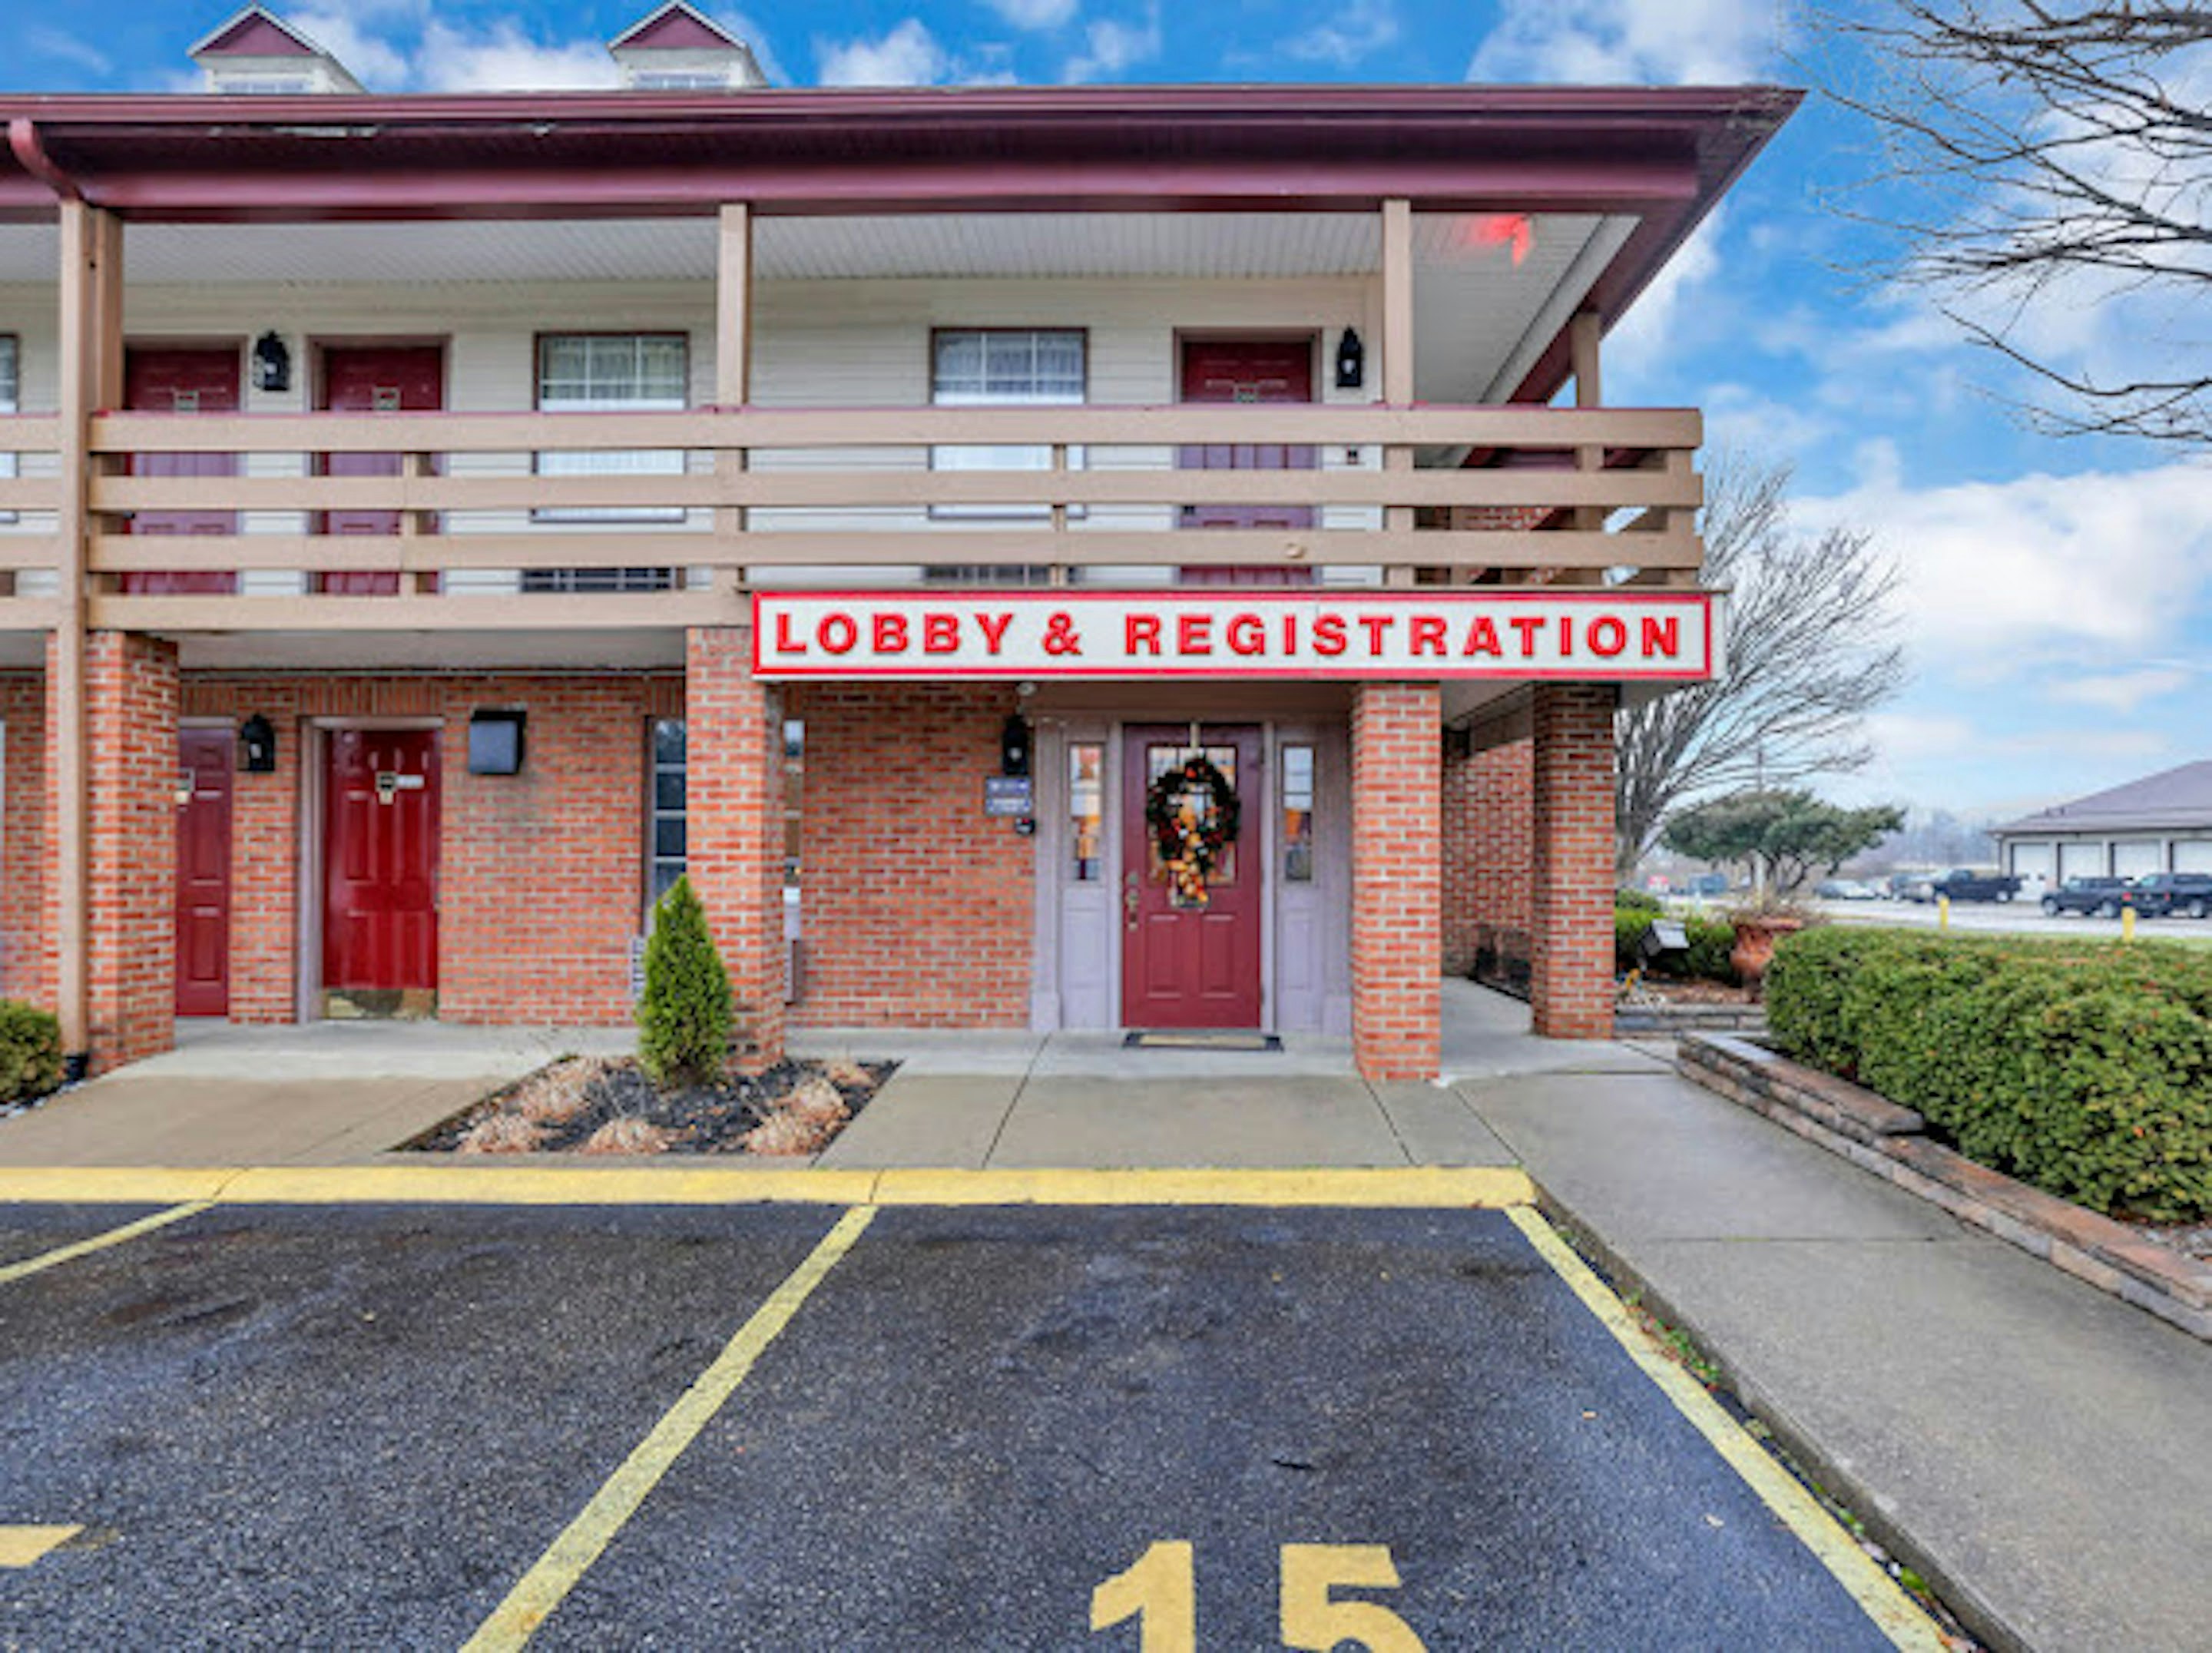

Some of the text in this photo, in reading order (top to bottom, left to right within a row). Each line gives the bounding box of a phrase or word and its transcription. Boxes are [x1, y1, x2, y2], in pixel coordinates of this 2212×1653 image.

[775, 611, 1680, 658] LOBBY & REGISTRATION
[1089, 1540, 1429, 1653] 15
